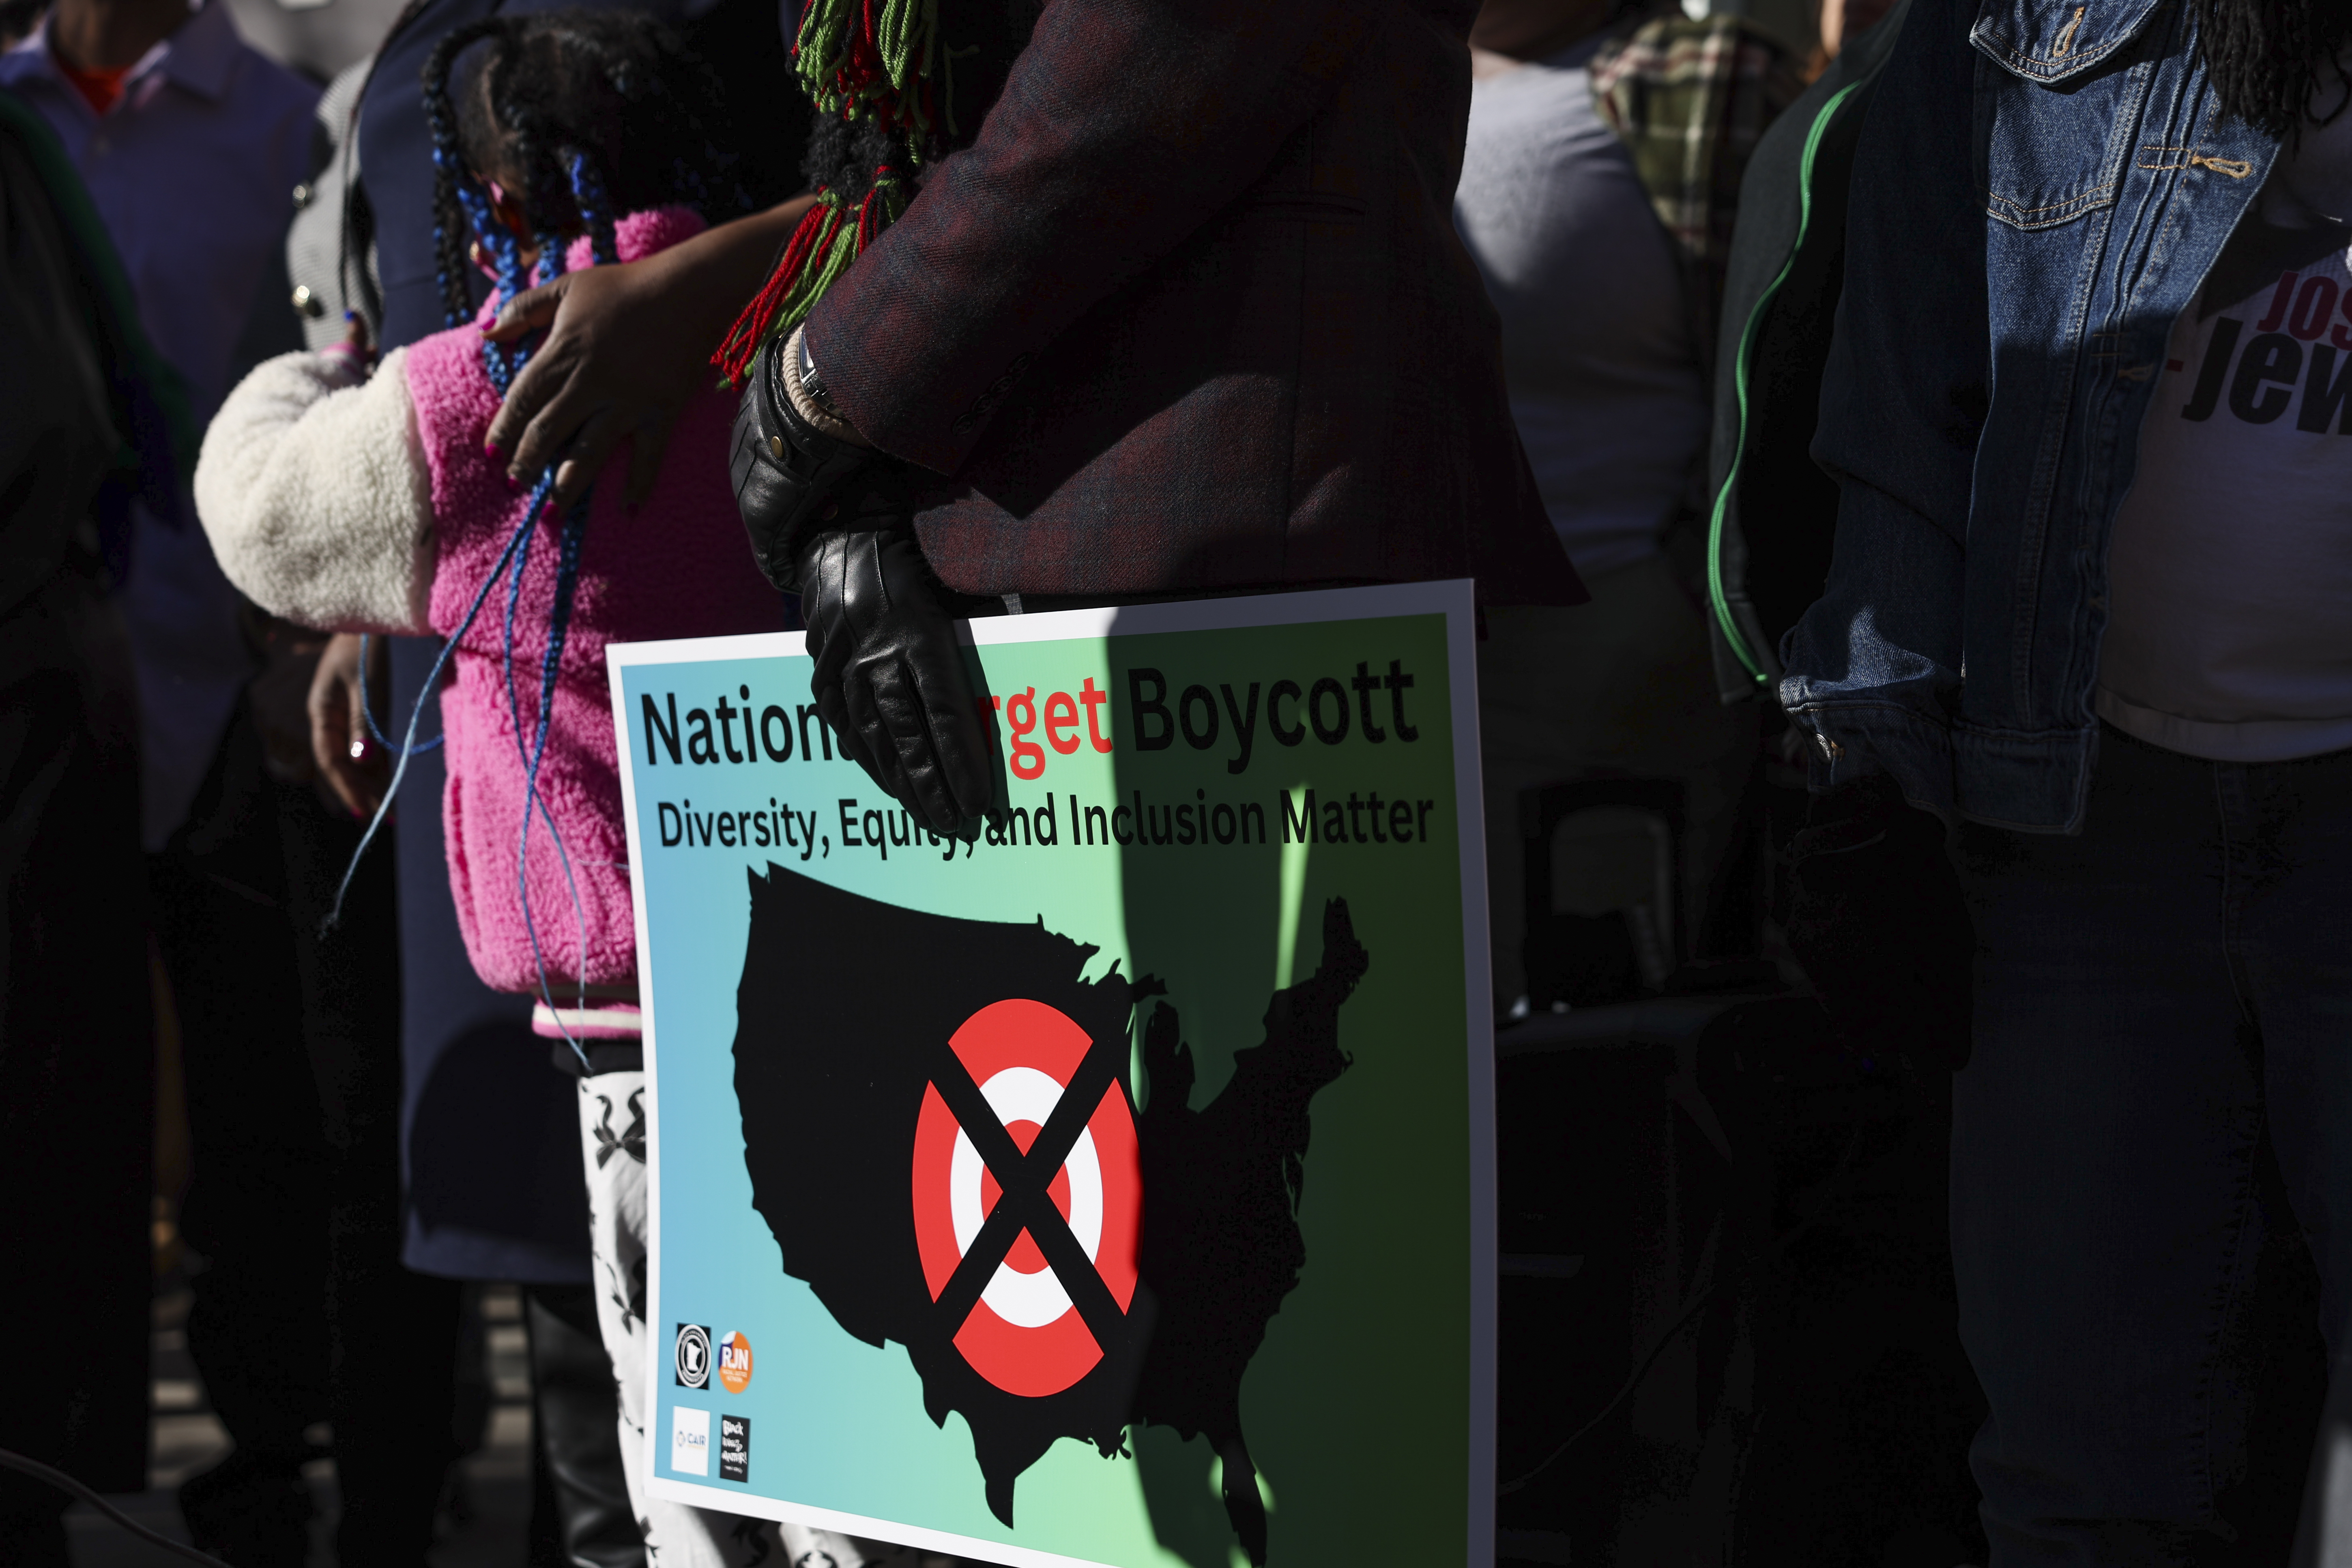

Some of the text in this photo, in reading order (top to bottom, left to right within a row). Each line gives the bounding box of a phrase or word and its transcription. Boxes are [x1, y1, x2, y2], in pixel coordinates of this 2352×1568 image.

[642, 659, 1419, 780] Nation rget Boycott
[658, 797, 829, 860] Diversity,
[985, 792, 1057, 846] and
[1070, 788, 1266, 845] Inclusion
[1280, 789, 1433, 843] Matter
[722, 1346, 749, 1371] RJN
